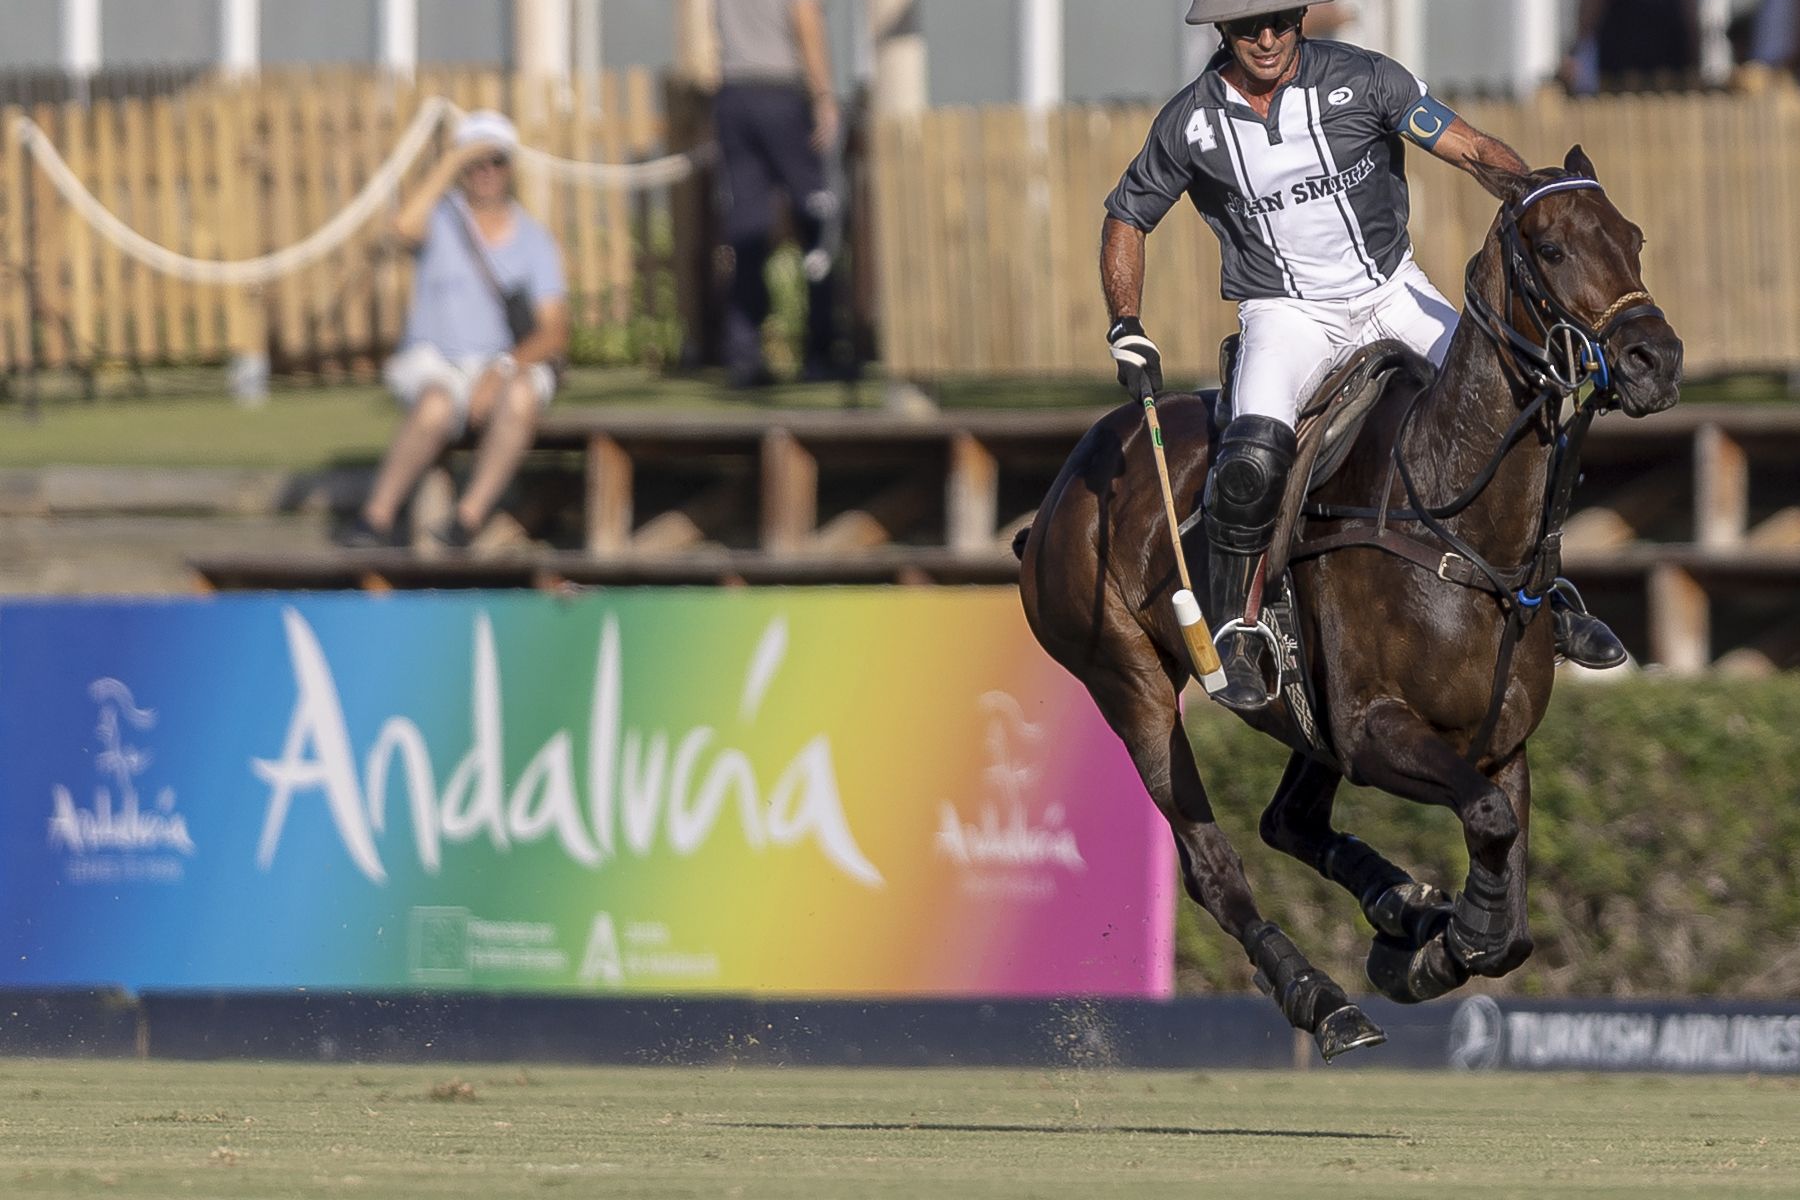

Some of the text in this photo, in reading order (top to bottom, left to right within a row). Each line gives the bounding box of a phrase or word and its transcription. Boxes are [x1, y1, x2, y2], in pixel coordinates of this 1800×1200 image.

[1184, 107, 1218, 153] 4
[1409, 106, 1443, 138] C
[1290, 149, 1375, 205] SMITH
[251, 604, 885, 888] Andalucía
[1507, 1011, 1654, 1065] TURKISH
